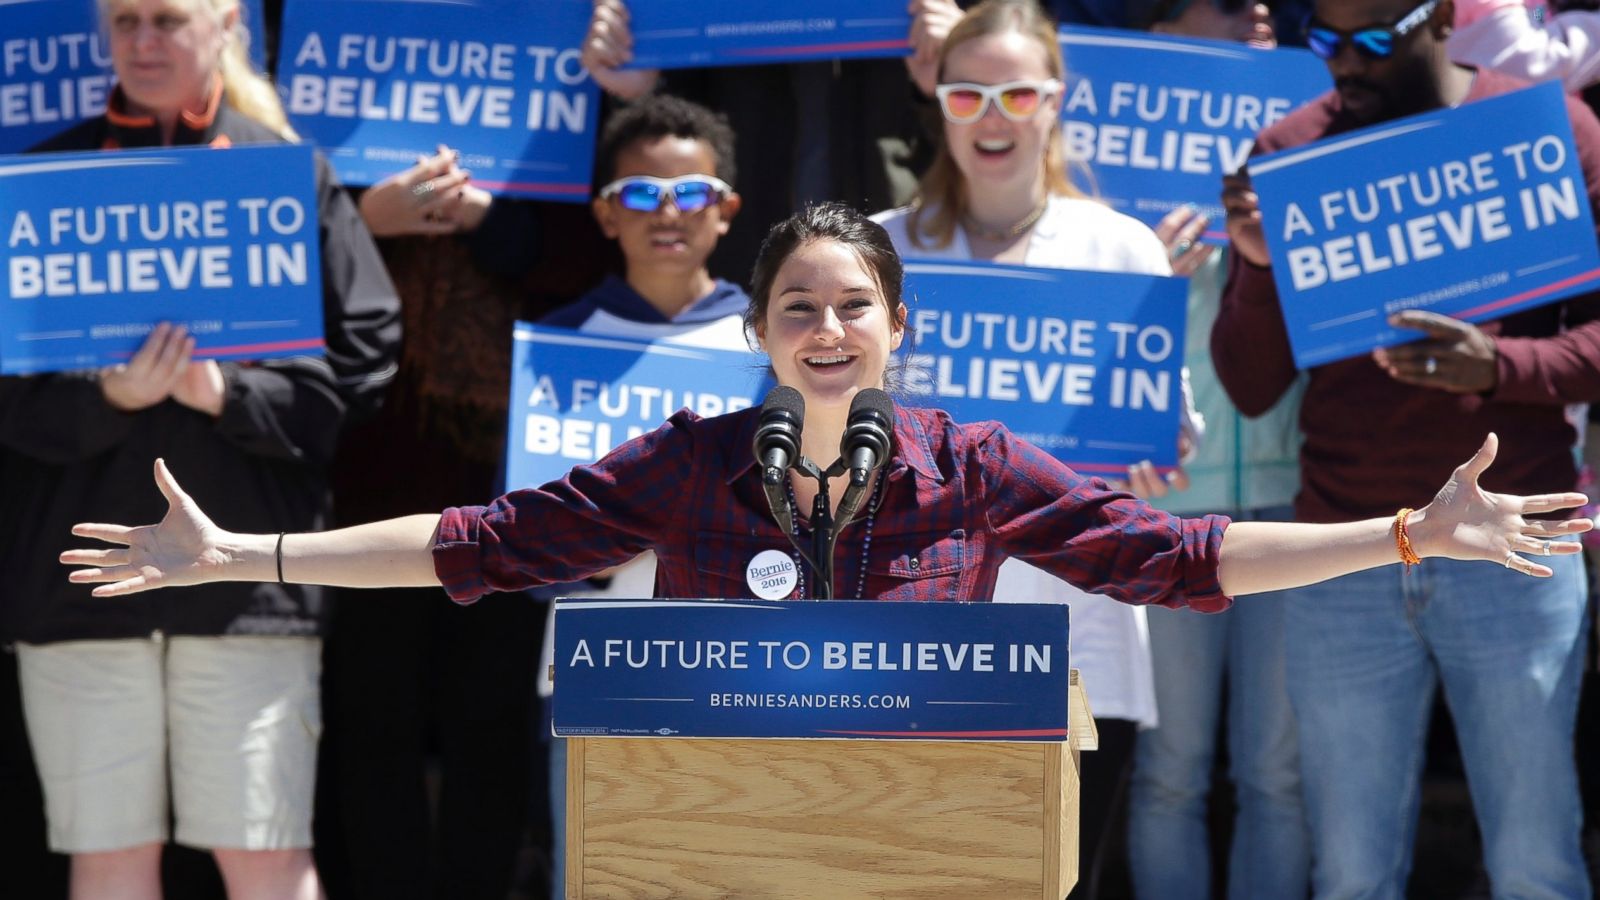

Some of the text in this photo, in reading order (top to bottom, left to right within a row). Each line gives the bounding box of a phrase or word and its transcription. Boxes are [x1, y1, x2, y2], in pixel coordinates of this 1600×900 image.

[4, 33, 112, 77] FUTU
[295, 31, 590, 85] A FUTURE TO
[290, 73, 587, 133] BELIEVE IN
[1065, 78, 1291, 131] A FUTURE
[1062, 119, 1255, 176] BELIEV
[1283, 202, 1314, 241] A
[1319, 152, 1499, 231] FUTURE
[1503, 134, 1565, 180] TO
[8, 196, 304, 247] A FUTURE TO
[1287, 176, 1580, 291] BELIEVE IN
[9, 241, 307, 298] BELIEVE IN
[913, 309, 1174, 363] FUTURE TO
[527, 374, 559, 411] A
[1110, 367, 1171, 412] IN
[750, 561, 793, 578] Bernie
[761, 576, 787, 589] 2016
[569, 639, 1051, 673] A FUTURE TO BELIEVE IN
[710, 693, 910, 709] BERNIESANDERS.COM
